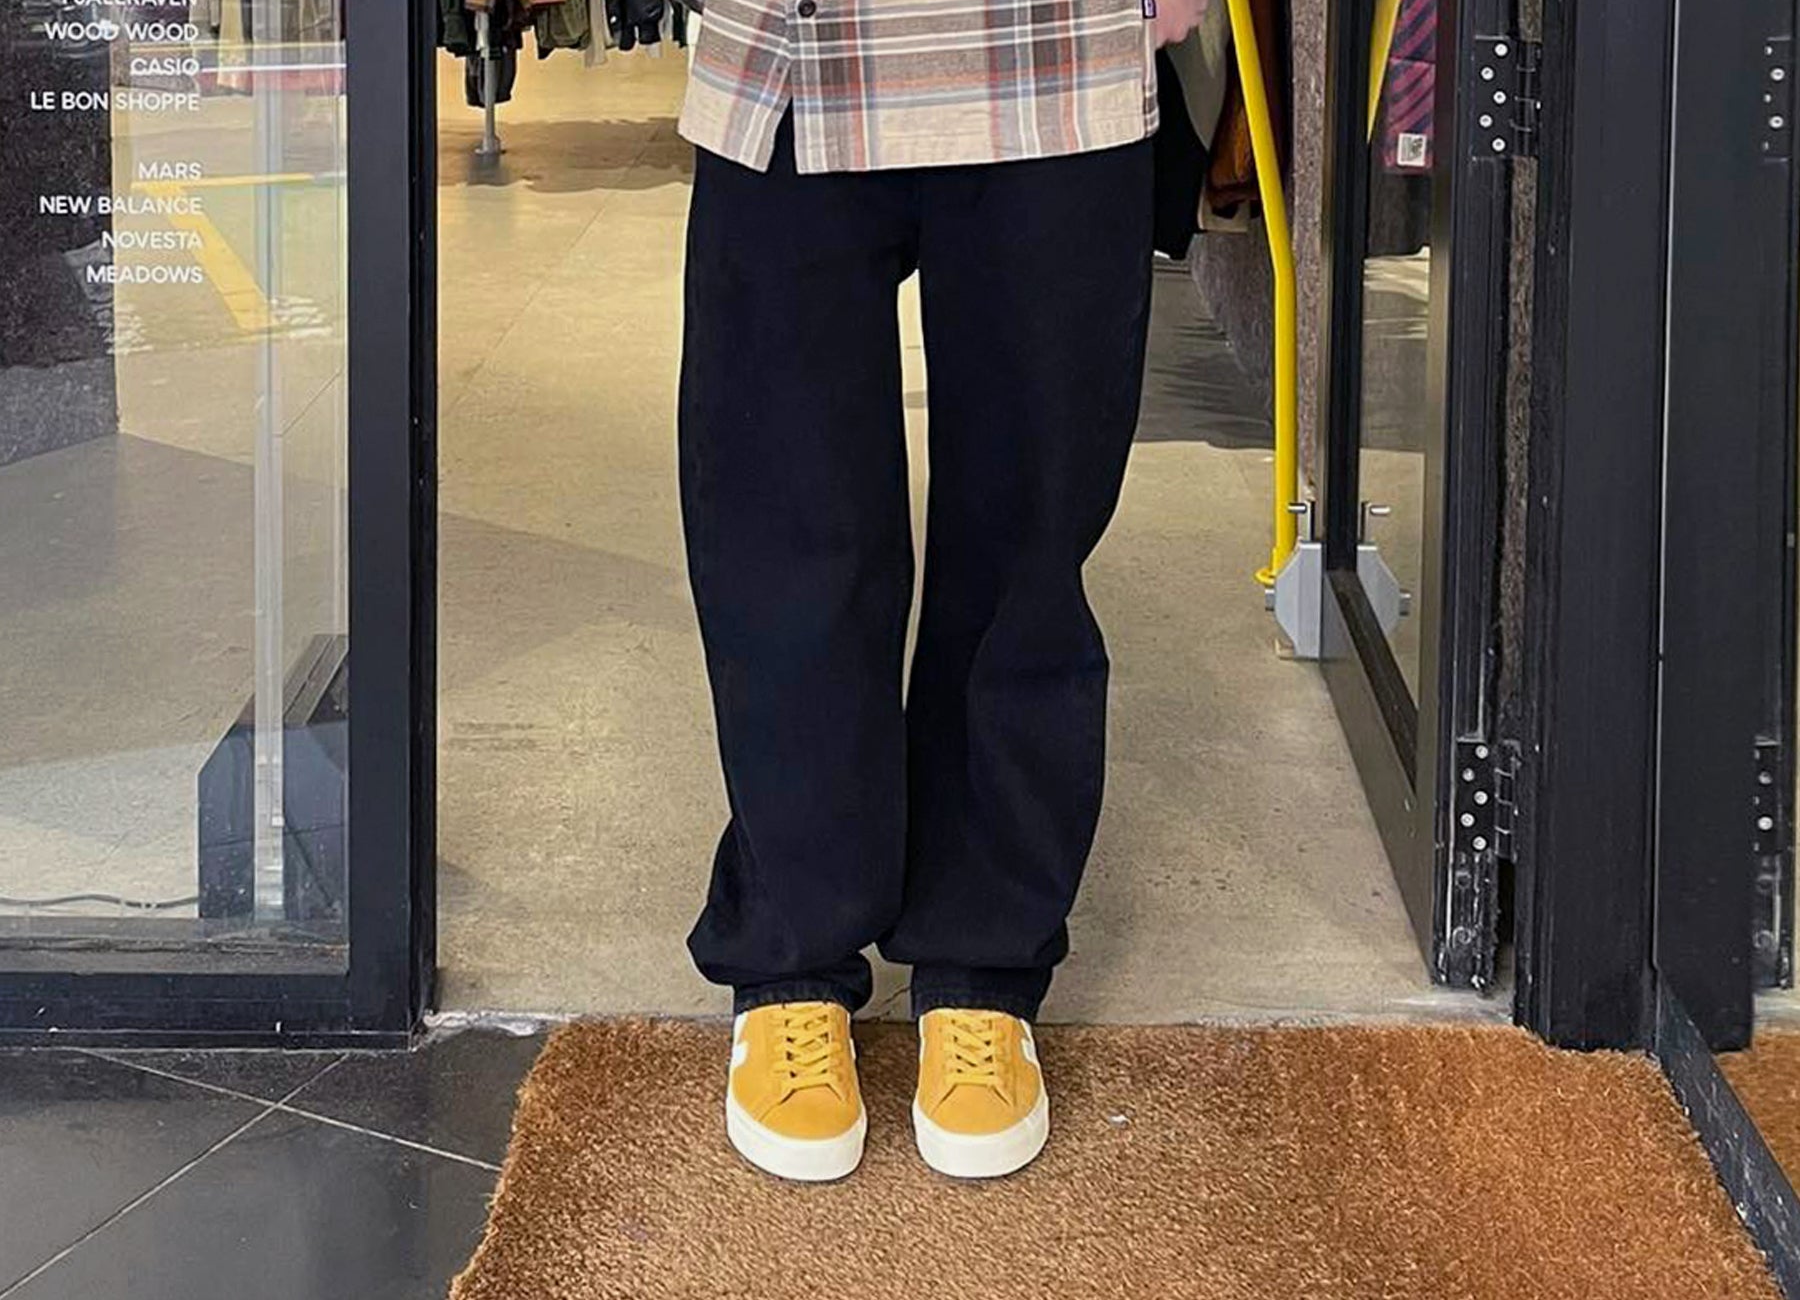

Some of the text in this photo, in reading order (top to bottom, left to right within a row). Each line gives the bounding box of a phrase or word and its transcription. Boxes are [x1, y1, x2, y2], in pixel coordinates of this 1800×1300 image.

[45, 21, 199, 41] WOOD WOOD
[130, 57, 199, 76] CASIO
[31, 91, 199, 111] LE BON SHOPPE
[139, 162, 202, 181] MARS
[40, 195, 203, 215] NEW BALANCE
[102, 230, 203, 249] NOVESTA
[87, 265, 203, 284] MEADOWS
